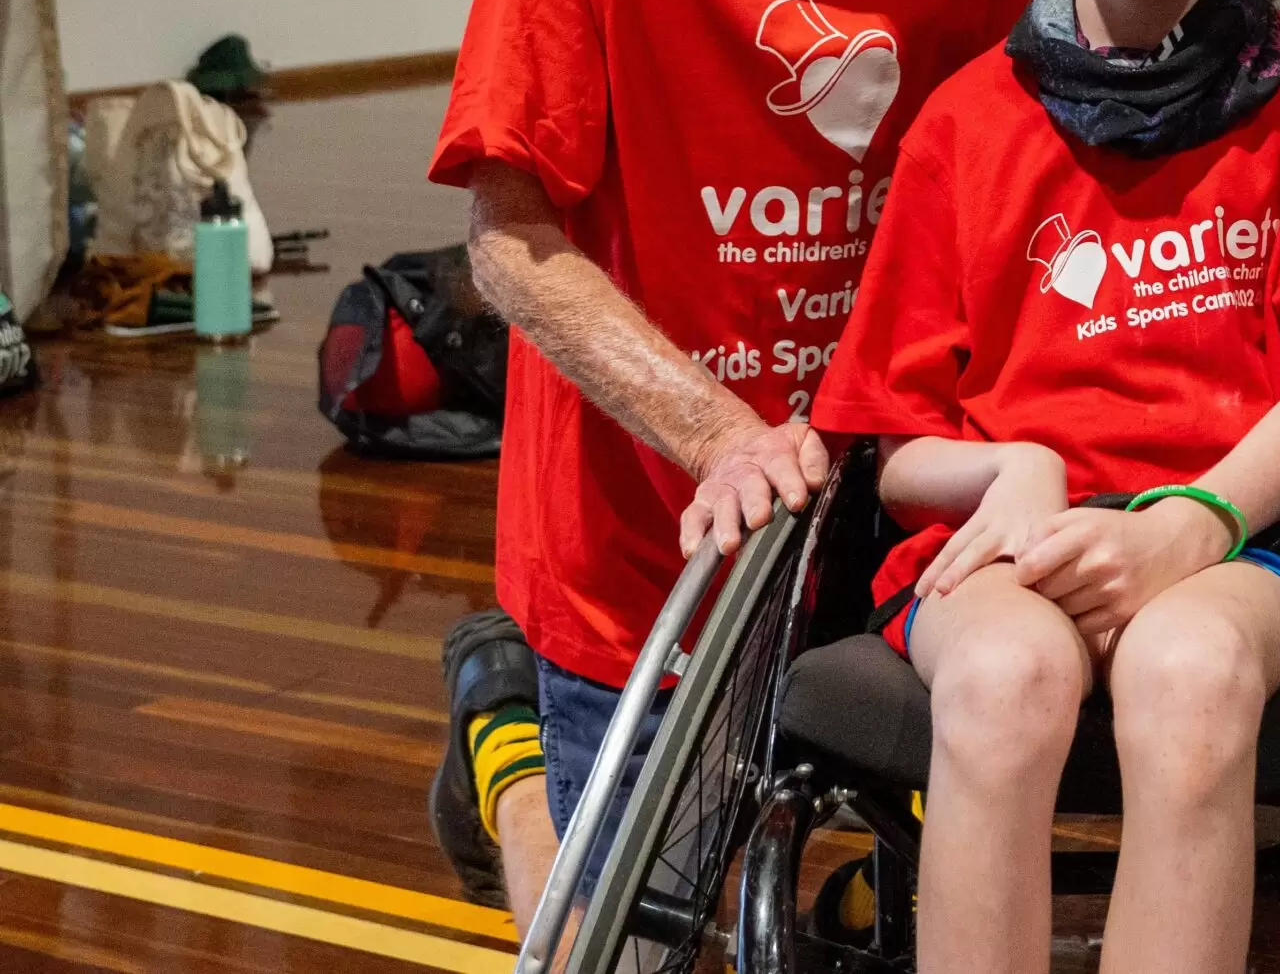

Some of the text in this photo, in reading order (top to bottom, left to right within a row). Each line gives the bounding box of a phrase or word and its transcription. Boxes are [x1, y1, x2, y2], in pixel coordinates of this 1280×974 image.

[717, 239, 868, 264] the children's
[1133, 280, 1165, 298] the
[1076, 314, 1118, 341] Kids
[1126, 301, 1189, 329] Sports
[691, 341, 762, 382] Kids
